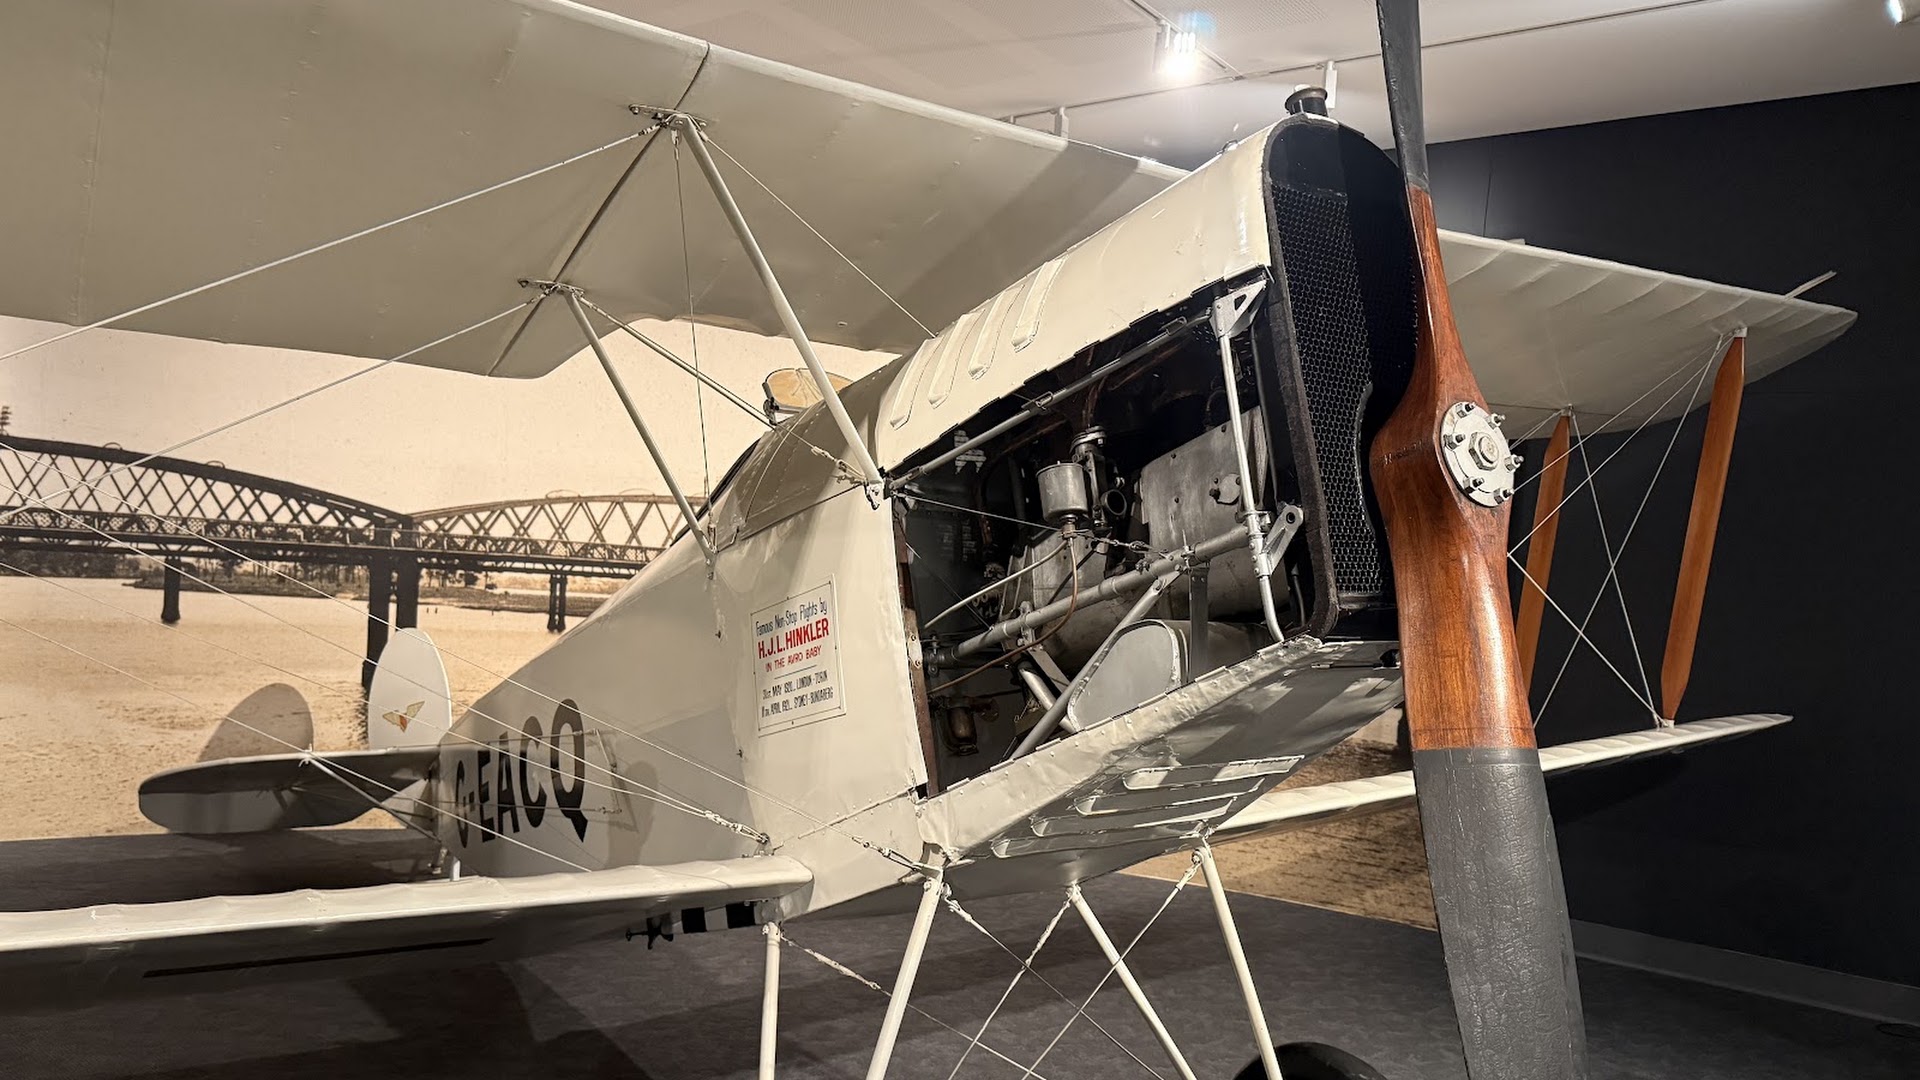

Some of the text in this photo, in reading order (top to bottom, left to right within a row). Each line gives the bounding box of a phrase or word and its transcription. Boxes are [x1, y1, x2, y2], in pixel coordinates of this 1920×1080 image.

[755, 620, 774, 637] Famous
[799, 601, 818, 622] Flights
[819, 597, 828, 615] by
[765, 645, 822, 673] IN THE AVRO BABY
[455, 698, 588, 848] G-EACQ
